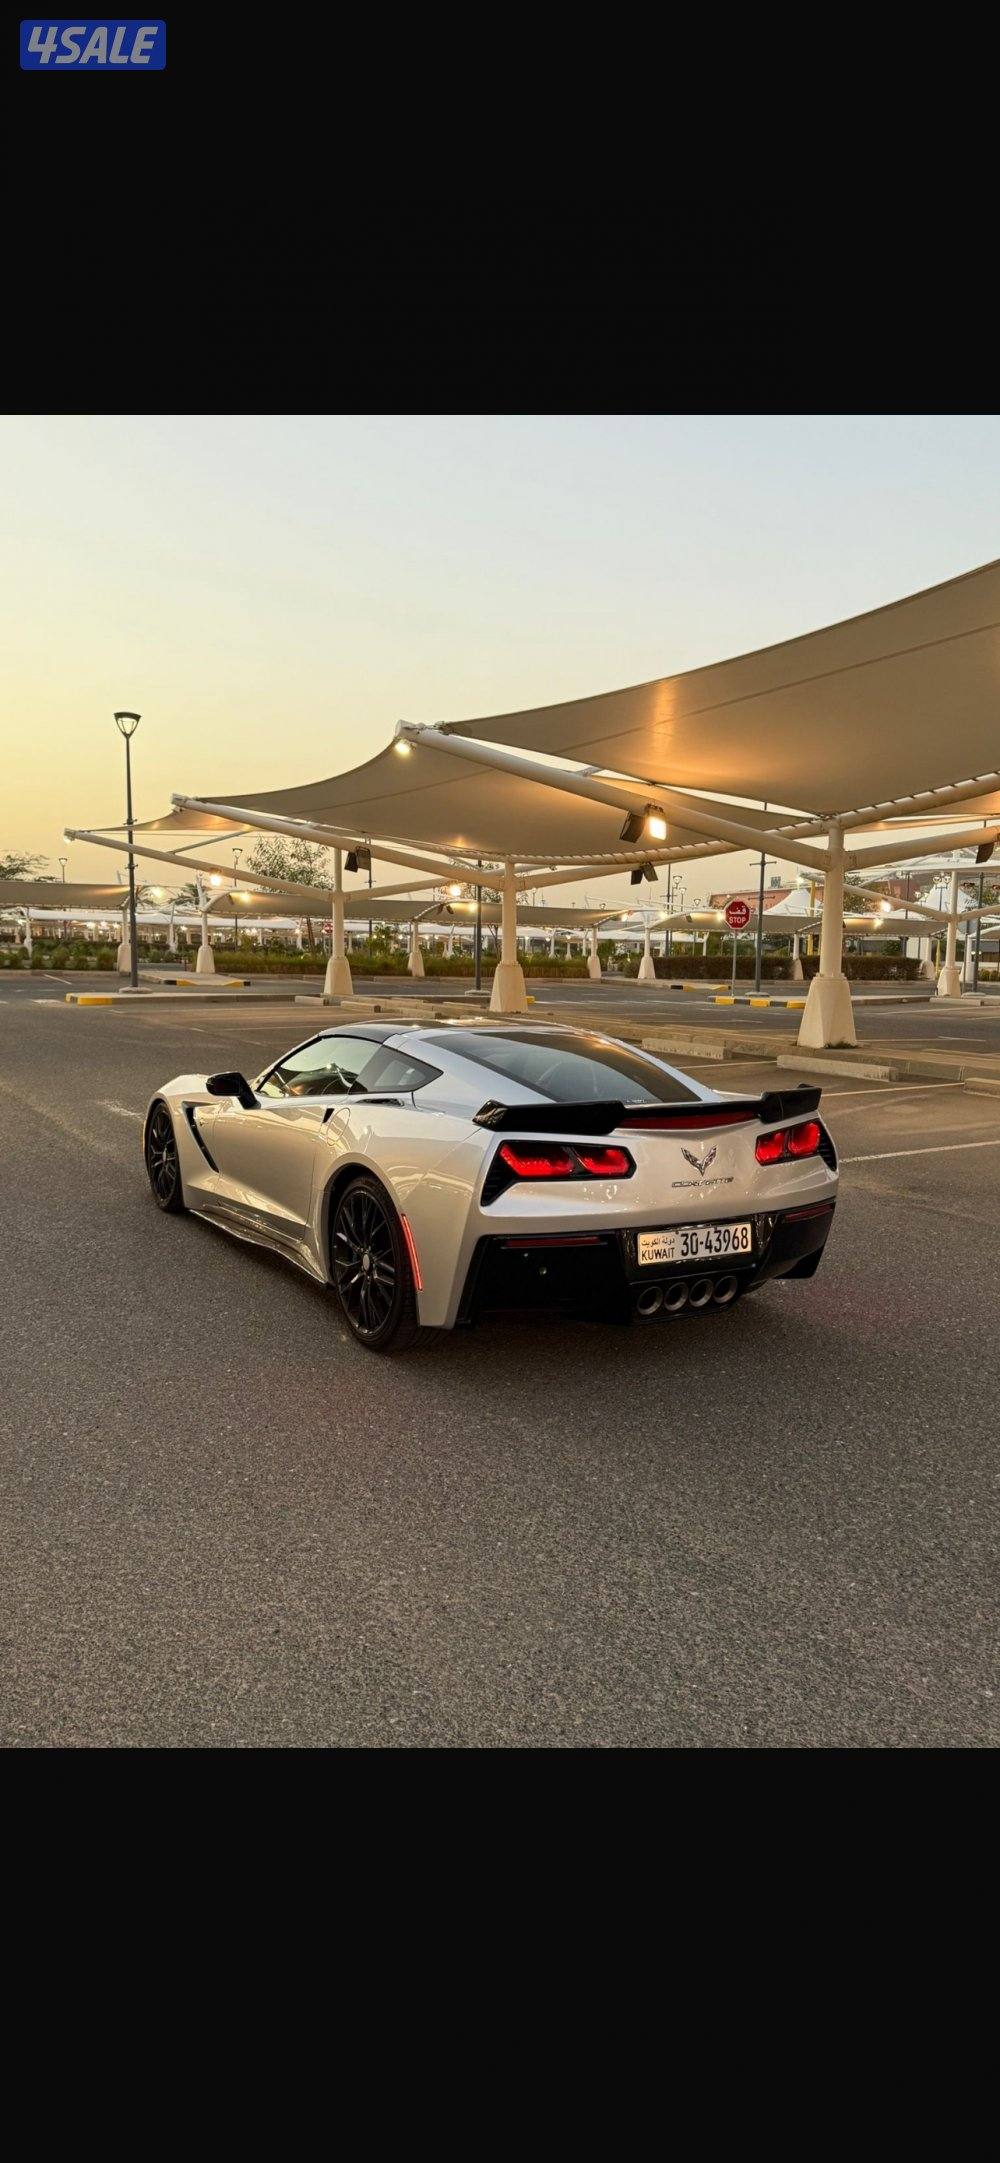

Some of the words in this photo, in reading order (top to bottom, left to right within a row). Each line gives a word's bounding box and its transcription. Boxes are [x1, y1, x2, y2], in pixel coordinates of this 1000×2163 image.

[729, 906, 746, 914] قف
[729, 916, 746, 924] STOP
[641, 1239, 661, 1248] الكويت
[662, 1238, 675, 1246] دولة
[680, 1227, 748, 1257] 30-43968
[641, 1247, 676, 1261] KUWAIT
